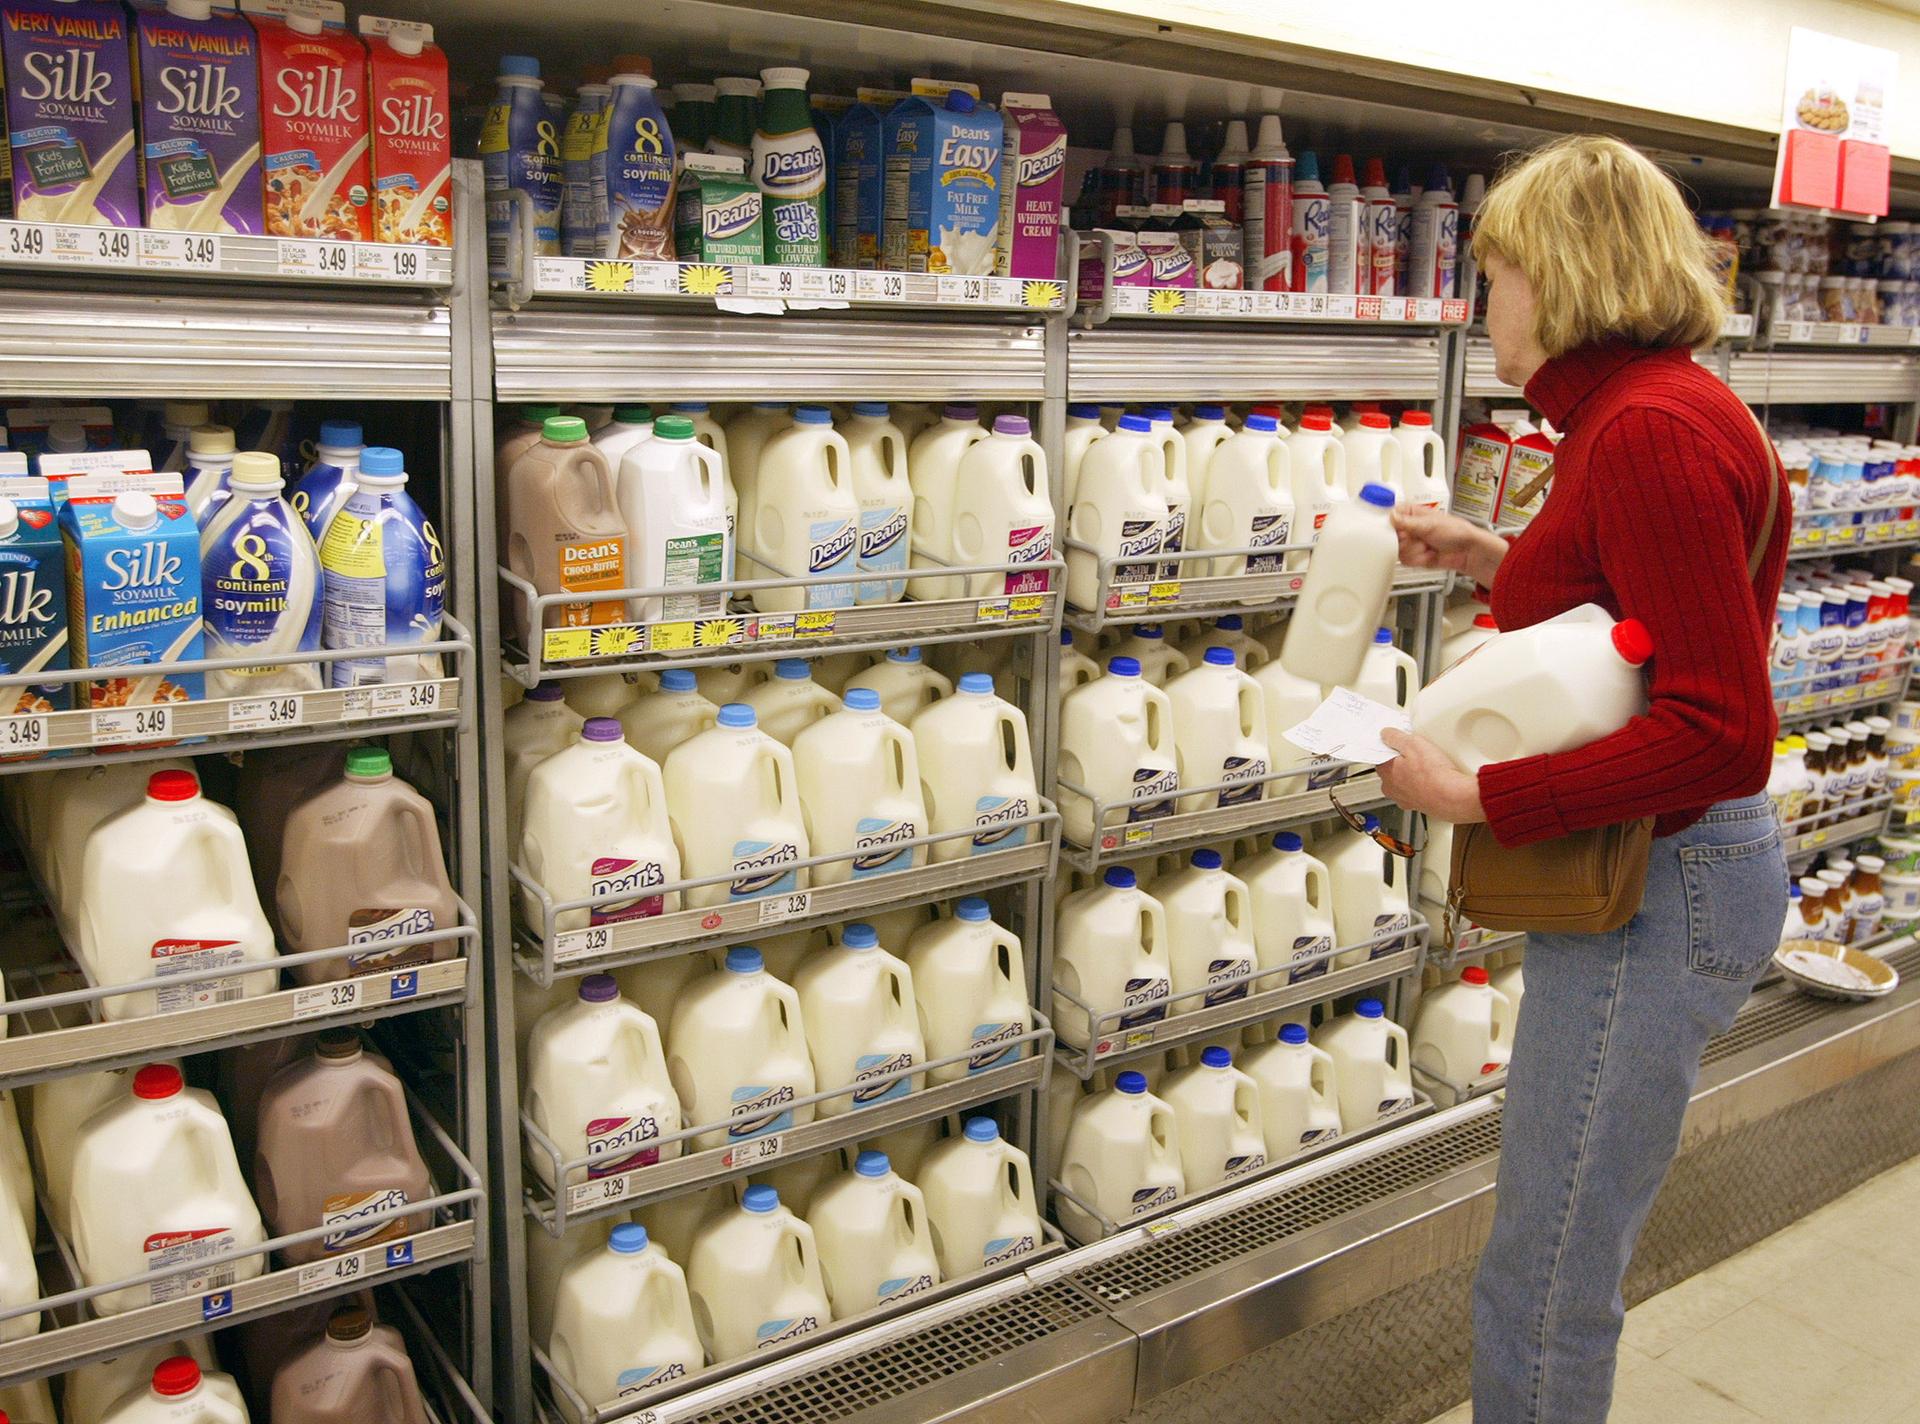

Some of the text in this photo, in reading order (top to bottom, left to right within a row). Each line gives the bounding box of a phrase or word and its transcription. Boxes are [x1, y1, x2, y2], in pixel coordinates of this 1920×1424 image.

[3, 9, 121, 40] VERY VANILLA
[143, 26, 250, 56] VERY VANILLA
[21, 49, 117, 106] Silk
[157, 65, 245, 119] Silk
[273, 66, 360, 122] Silk
[39, 102, 104, 118] SOYMILK
[379, 95, 447, 139] Silk
[19, 128, 62, 139] CALCIUM
[172, 115, 233, 132] SOYMILK
[286, 120, 353, 139] SOYMILK
[952, 125, 991, 141] Dean's
[299, 134, 341, 144] ORGANIC
[388, 137, 442, 152] SOYMILK
[635, 117, 663, 154] 8
[154, 141, 193, 152] CALCIUM
[939, 139, 998, 173] Easy
[35, 157, 84, 177] Fortified
[37, 151, 62, 164] Kids
[623, 152, 672, 166] continent
[766, 146, 823, 179] Dean's
[1021, 148, 1064, 183] Dean's
[168, 169, 212, 187] Fortified
[170, 162, 194, 175] Kids
[623, 166, 673, 182] soymilk
[947, 191, 988, 206] FAT FREE
[1025, 200, 1054, 213] HEAVY
[705, 198, 761, 235] Dean's
[954, 203, 980, 216] MILK
[1017, 212, 1059, 225] WHIPPING
[10, 228, 44, 255] 3.49
[1022, 225, 1053, 237] CREAM
[98, 231, 130, 258] 3.49
[184, 237, 215, 263] 3.49
[775, 245, 819, 254] CULTURED
[1206, 242, 1240, 252] WHIPPING
[1211, 250, 1236, 258] CREAM
[319, 246, 346, 271] 3.49
[393, 251, 417, 276] 1.99
[781, 254, 815, 263] LOWFAT
[1155, 251, 1192, 276] Dean's
[828, 274, 846, 295] 1.59
[884, 276, 901, 297] 3.29
[964, 280, 980, 300] 3.29
[1358, 302, 1380, 317] FREE
[1443, 304, 1466, 319] FREE
[1467, 438, 1502, 455] HORIZON
[861, 515, 907, 555] Dean's
[1120, 529, 1163, 556] Dean's
[1249, 521, 1288, 547] Dean's
[565, 542, 620, 563] Dean's
[667, 540, 698, 550] Dean's
[809, 527, 856, 569] Dean's
[1008, 533, 1051, 563] Dean's
[103, 542, 185, 591] Silk
[230, 534, 270, 581] 8
[114, 587, 177, 602] SOYMILK
[216, 578, 287, 592] continent
[1012, 581, 1042, 594] LOWFAT
[0, 571, 57, 625] lk
[215, 596, 288, 615] soymilk
[92, 597, 197, 634] Enhanced
[410, 685, 435, 707] 3.49
[269, 700, 297, 722] 3.49
[9, 720, 41, 744] 3.49
[136, 710, 166, 734] 3.49
[1133, 771, 1177, 799] Dean's
[592, 862, 664, 900] Dean's
[788, 895, 807, 914] 3.29
[350, 910, 433, 962] Dean's
[586, 930, 607, 950] 3.29
[331, 984, 356, 1006] 3.29
[1125, 979, 1169, 1007] Dean's
[588, 1117, 659, 1155] Dean's
[759, 1138, 778, 1157] 3.29
[604, 1178, 624, 1198] 3.29
[335, 1257, 359, 1278] 4.29
